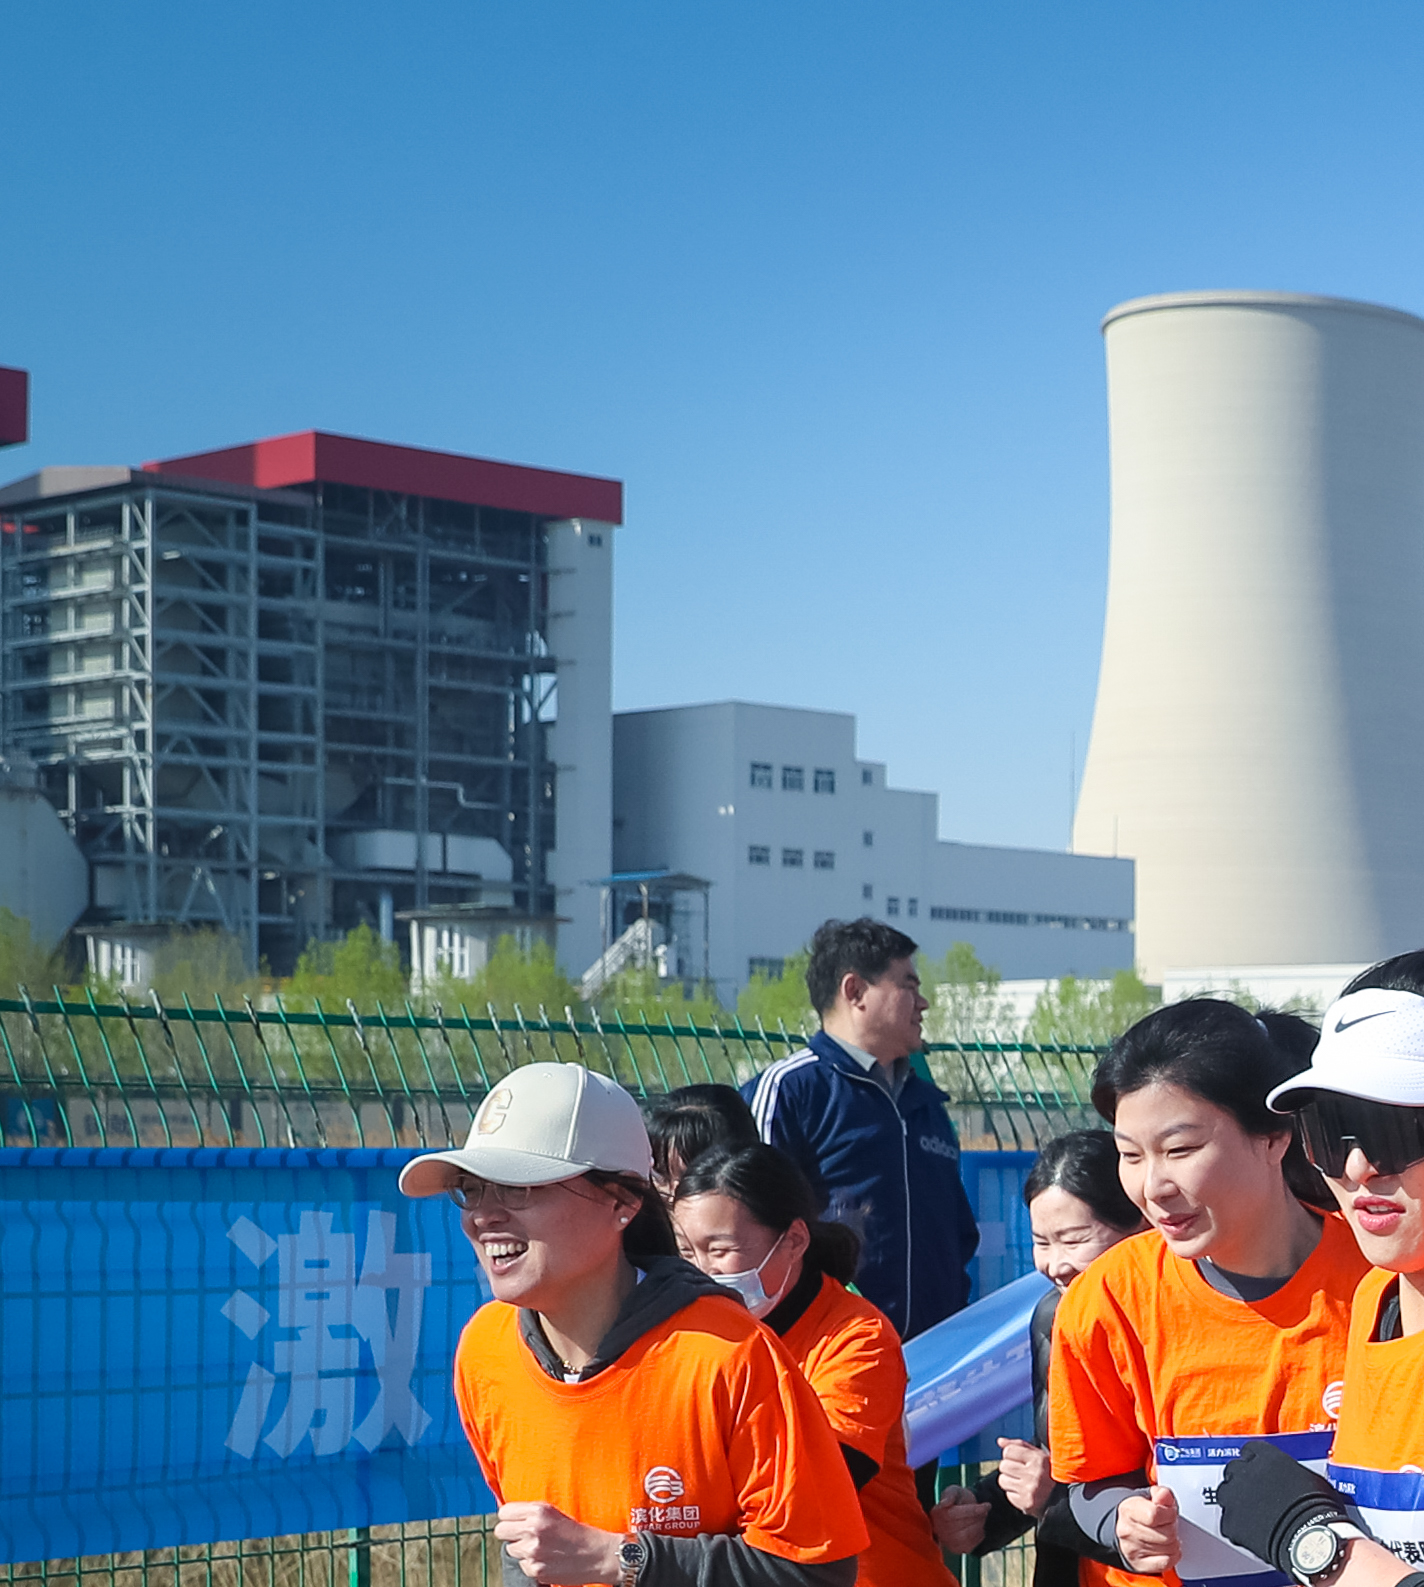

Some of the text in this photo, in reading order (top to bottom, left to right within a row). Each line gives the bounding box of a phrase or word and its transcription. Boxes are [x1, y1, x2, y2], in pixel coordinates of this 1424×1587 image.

[222, 1210, 433, 1460] 激
[630, 1505, 700, 1523] 滨化集团
[664, 1521, 701, 1530] GROUP
